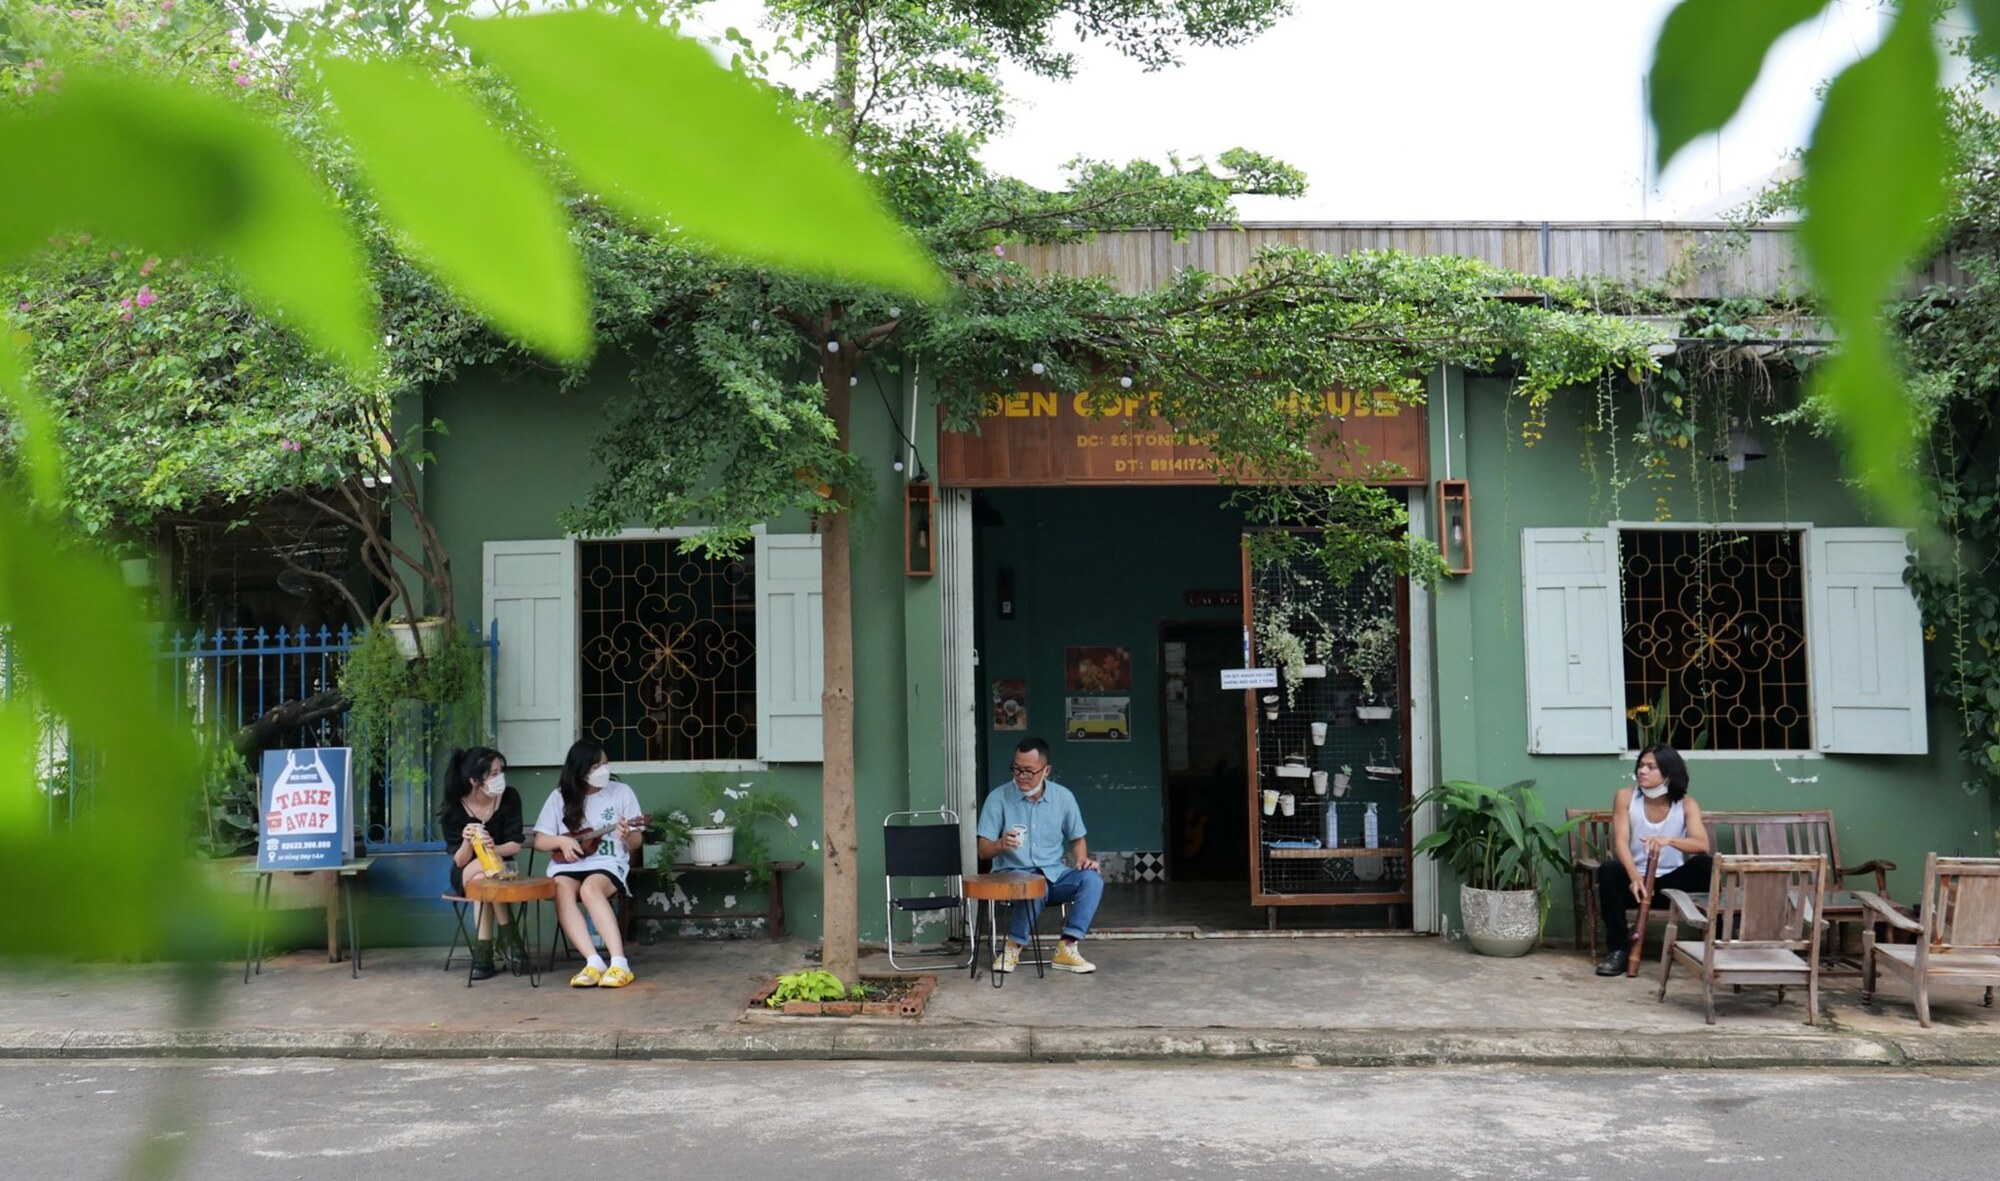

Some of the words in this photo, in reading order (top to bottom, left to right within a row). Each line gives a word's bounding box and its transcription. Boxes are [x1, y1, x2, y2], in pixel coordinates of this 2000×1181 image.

[1073, 391, 1190, 417] COFF
[276, 789, 331, 810] TAKE
[286, 812, 329, 832] AWAY
[599, 840, 617, 857] 31
